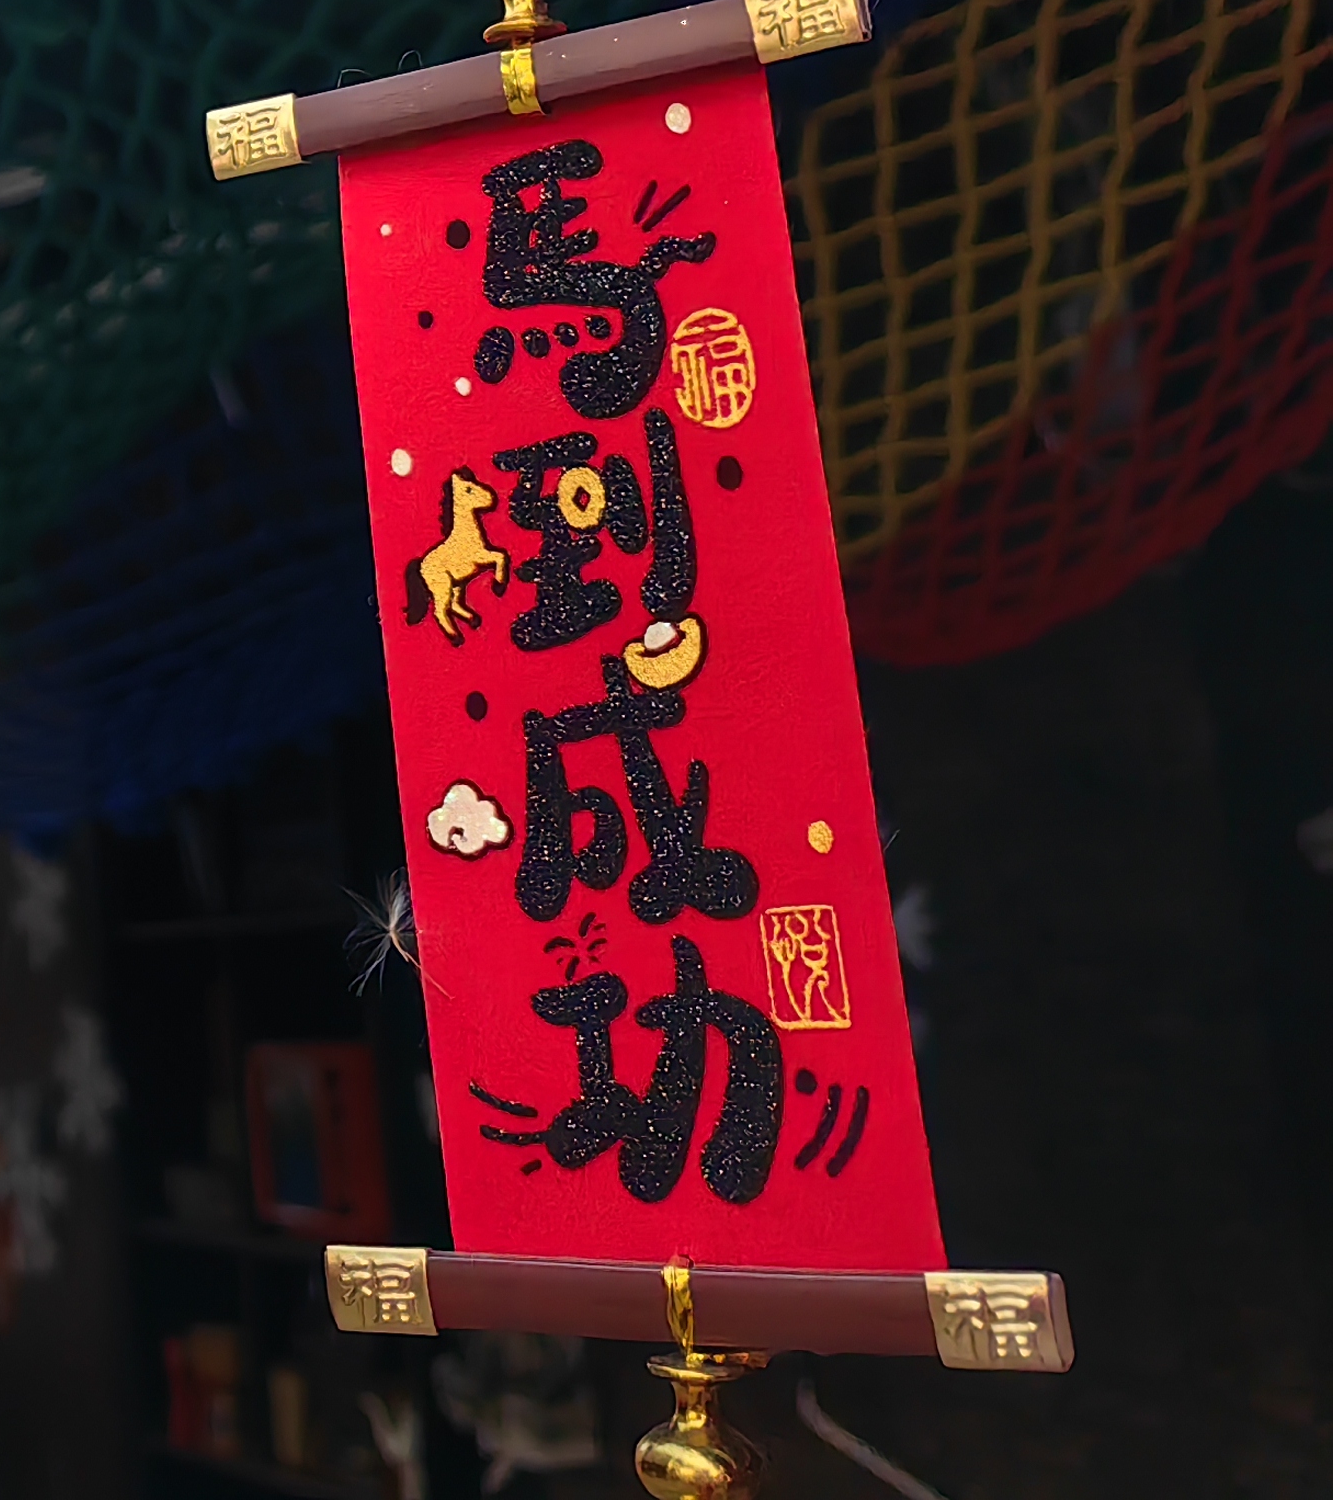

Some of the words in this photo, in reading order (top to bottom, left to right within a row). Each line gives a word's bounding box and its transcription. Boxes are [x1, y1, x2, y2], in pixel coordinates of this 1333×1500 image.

[217, 105, 291, 168] 福
[671, 307, 757, 429] 福
[474, 139, 783, 1204] 馬到成功
[339, 1255, 425, 1326] 福
[940, 1284, 1039, 1362] 福
